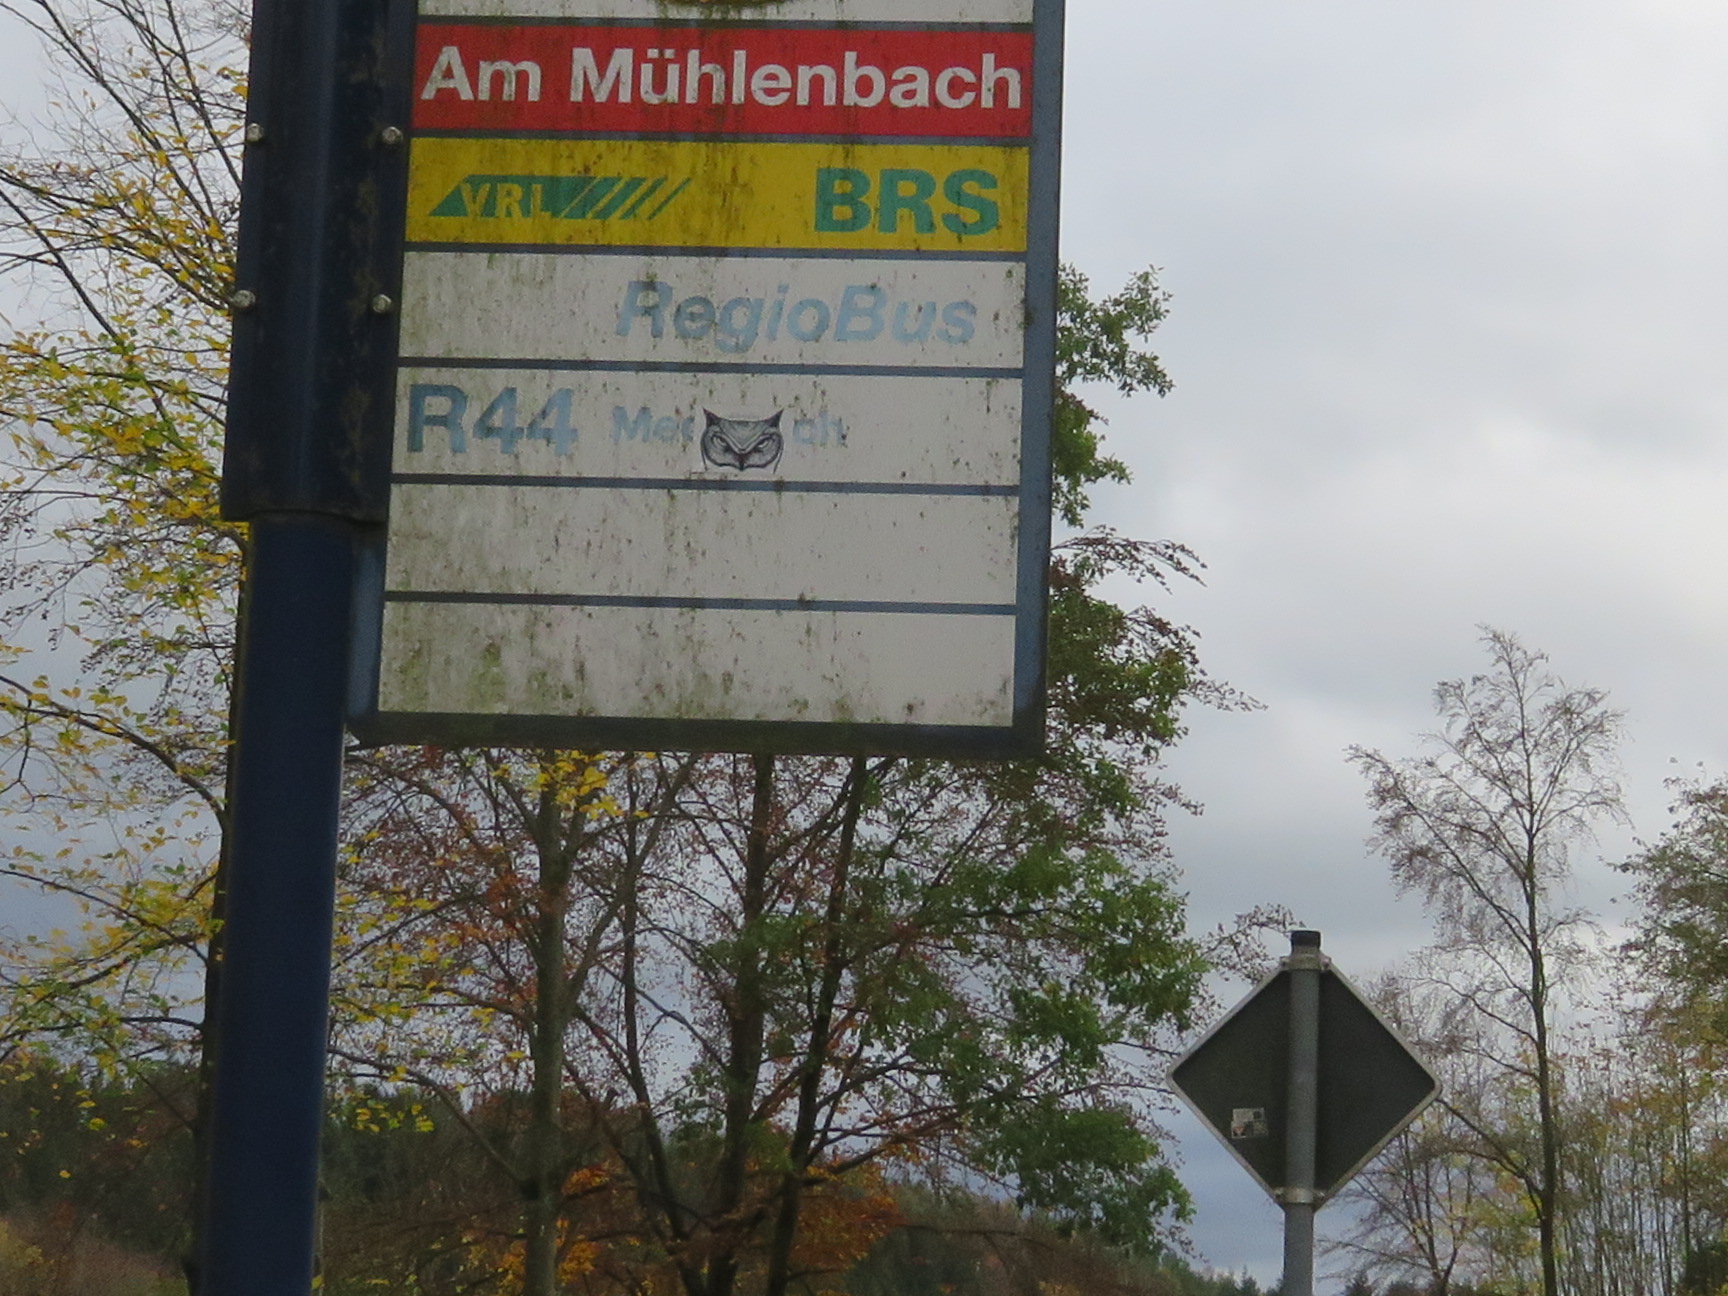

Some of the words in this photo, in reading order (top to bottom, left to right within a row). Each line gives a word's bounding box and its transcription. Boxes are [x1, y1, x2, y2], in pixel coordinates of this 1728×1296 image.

[421, 45, 541, 103] Am
[569, 46, 1022, 110] Mühlenbach
[461, 182, 553, 219] VRL
[813, 167, 1001, 235] BRS
[615, 280, 977, 355] RegioBus
[407, 383, 579, 456] R44
